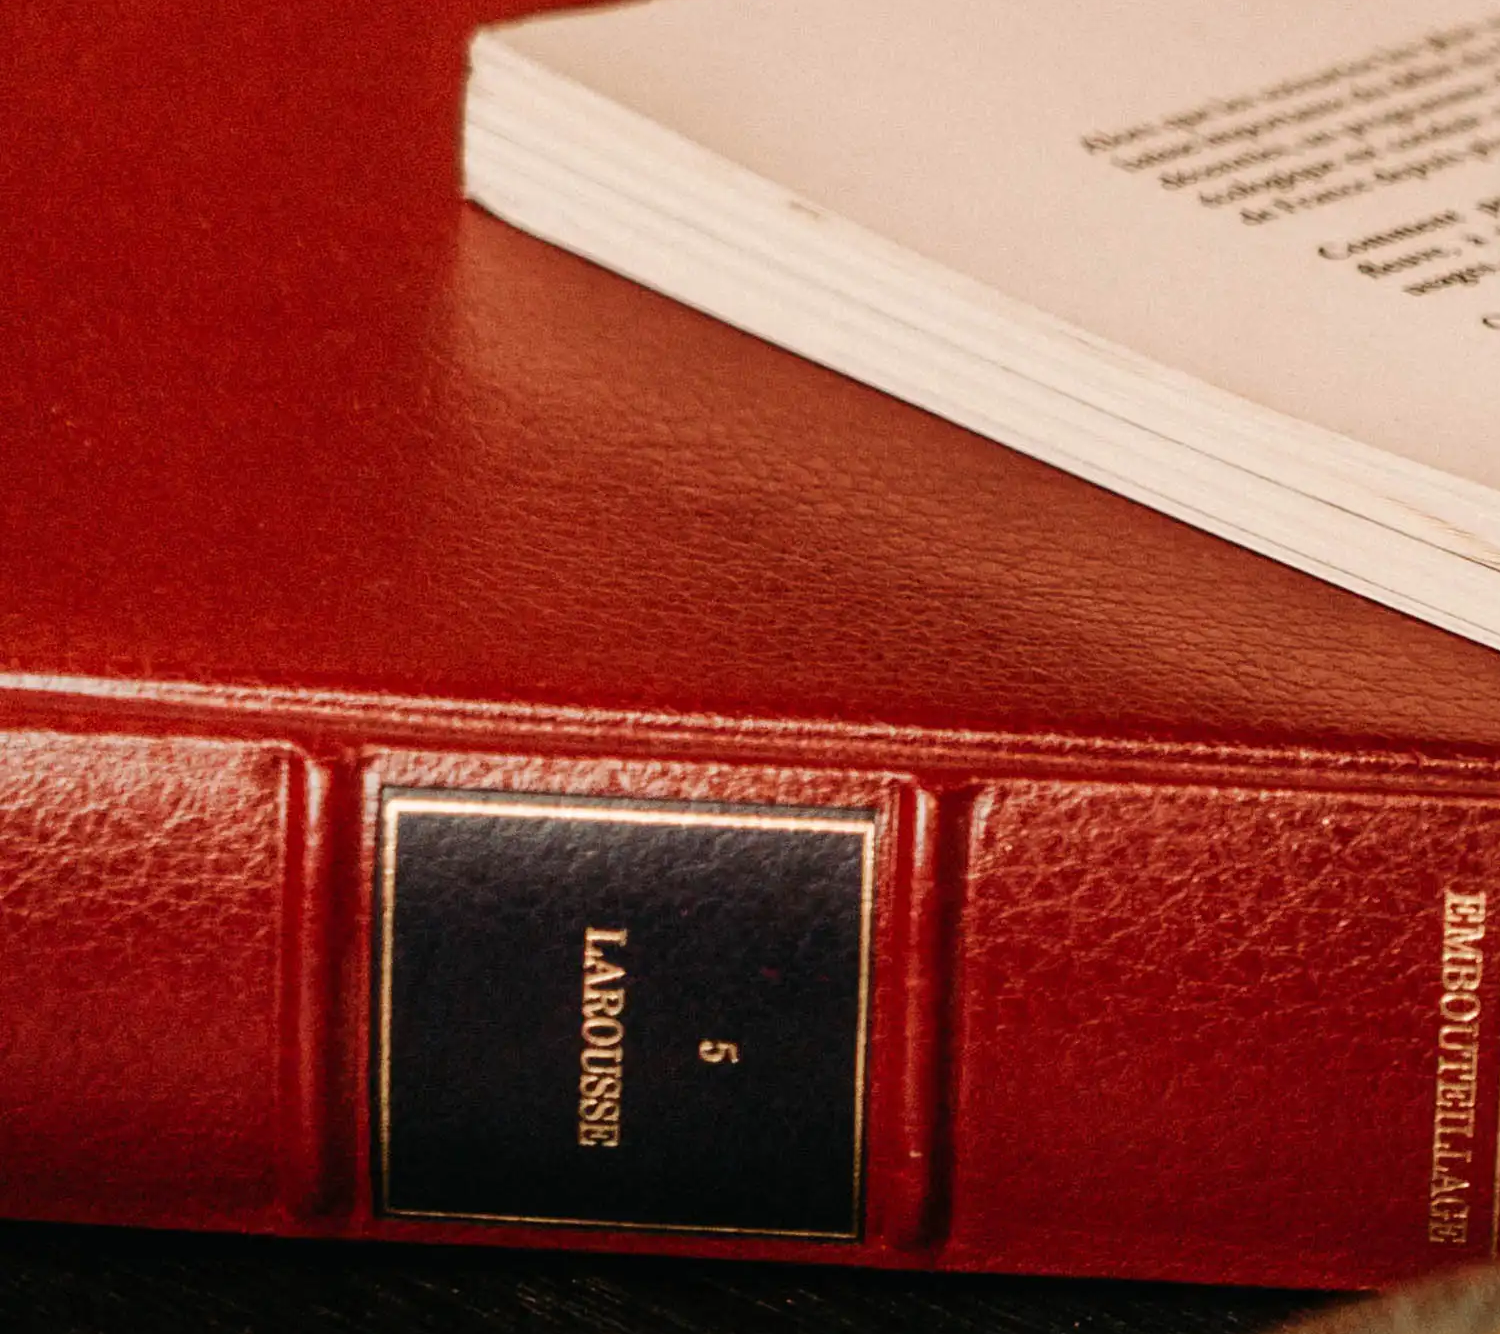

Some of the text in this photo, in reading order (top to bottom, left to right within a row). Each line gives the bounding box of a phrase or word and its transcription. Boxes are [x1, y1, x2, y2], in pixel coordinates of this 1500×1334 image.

[577, 925, 630, 1150] LAROUSSE
[698, 1038, 740, 1065] 5
[1427, 888, 1488, 1244] EMBOUTEILLAGE
